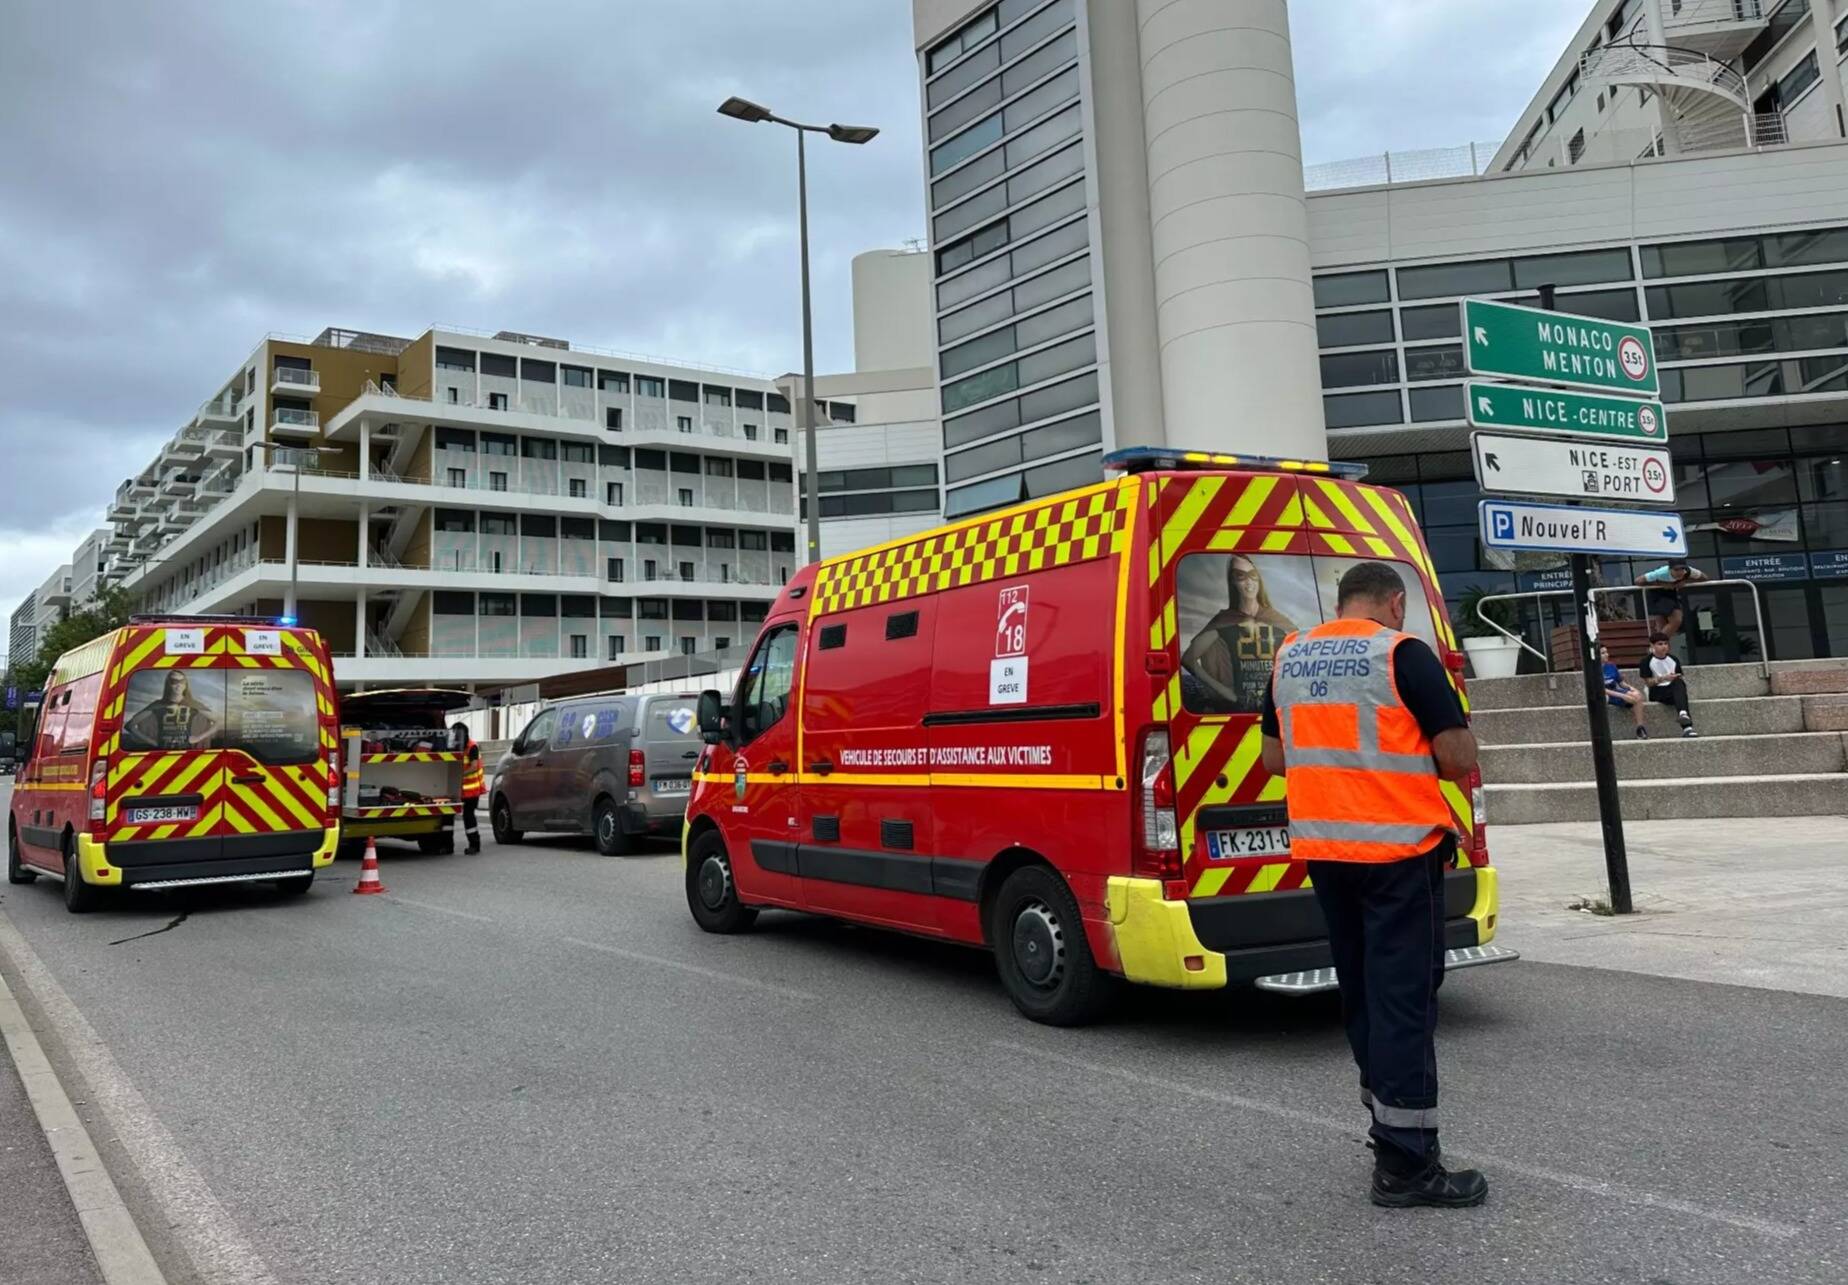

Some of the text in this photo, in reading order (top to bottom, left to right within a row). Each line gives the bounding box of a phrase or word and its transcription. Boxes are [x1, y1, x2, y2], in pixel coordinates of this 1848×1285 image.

[1537, 321, 1612, 351] MONACO
[1542, 350, 1616, 379] MENTON
[1603, 474, 1641, 493] PORT
[1521, 515, 1607, 541] Nouvel'R
[1001, 590, 1018, 605] 112
[1005, 625, 1023, 652] 18
[1288, 639, 1370, 658] SAPEURS
[1004, 667, 1014, 677] EN
[1240, 660, 1274, 672] MINUTES
[1281, 658, 1370, 679] POMPIERS
[1310, 681, 1328, 697] 06
[873, 751, 883, 765] DE
[884, 749, 916, 765] SECOURS
[917, 749, 928, 764] ET
[930, 748, 985, 765] D'ASSISTANCE
[987, 747, 1006, 765] AUX
[1007, 746, 1052, 765] VICTIMES
